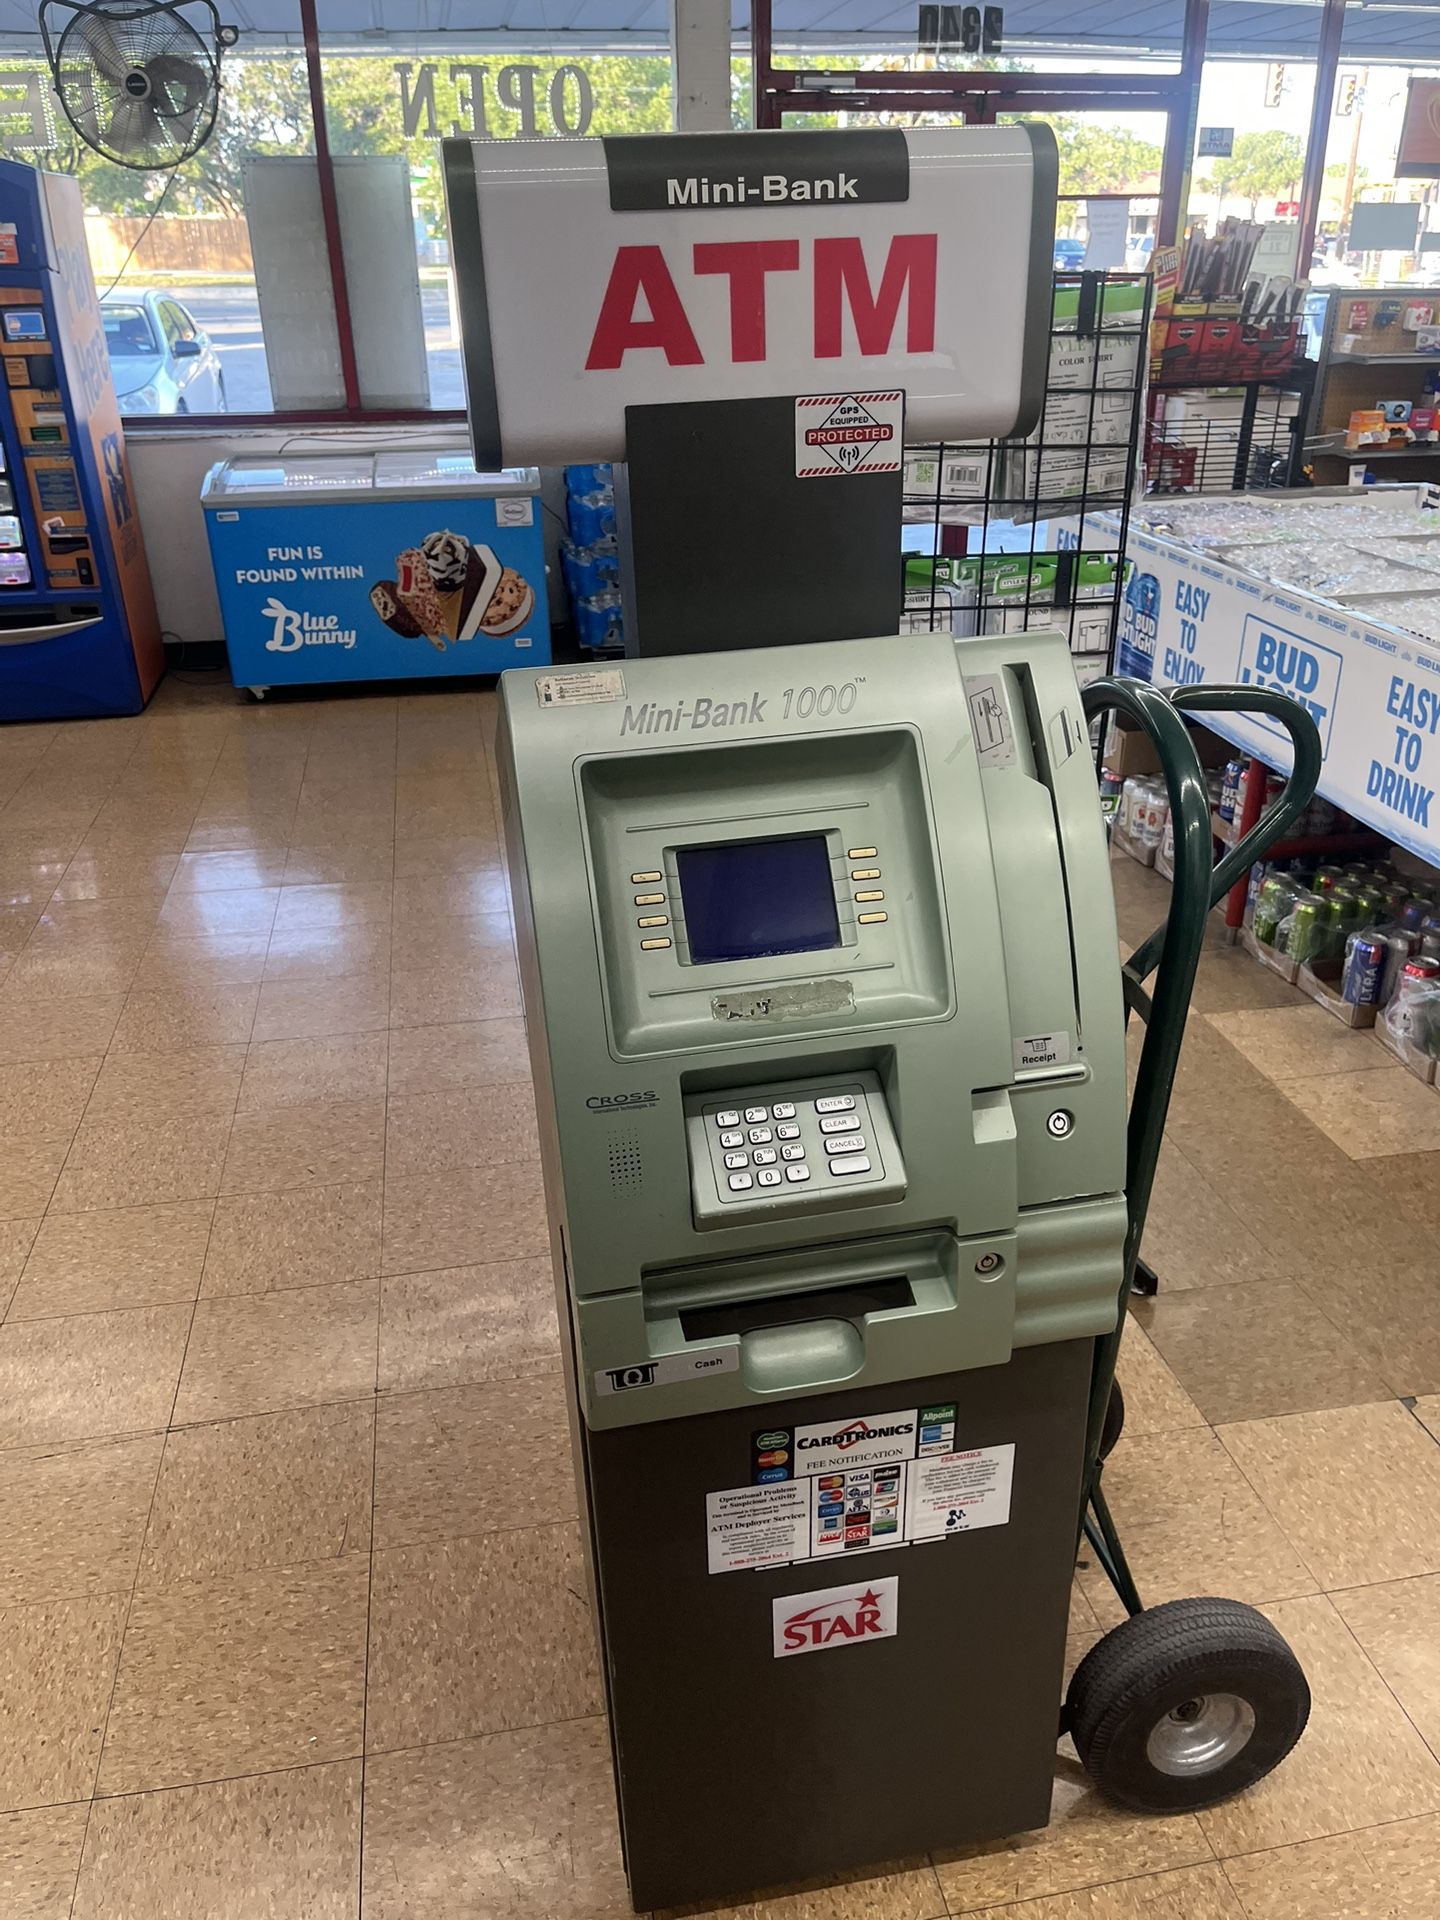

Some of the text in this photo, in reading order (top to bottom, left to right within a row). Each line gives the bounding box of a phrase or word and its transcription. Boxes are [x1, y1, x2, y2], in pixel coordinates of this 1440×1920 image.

[667, 173, 859, 205] Mini-Bank
[585, 233, 938, 371] ATM
[1059, 357, 1085, 367] COLOR
[840, 406, 859, 415] GPS
[830, 416, 869, 426] EQUIPPED
[808, 428, 890, 444] PROTECTED
[268, 546, 323, 562] FUN IS
[236, 565, 364, 584] FOUND WITHIN
[1175, 579, 1210, 622] EASY
[1028, 608, 1049, 616] OUND
[1135, 614, 1157, 639] BUD
[1329, 620, 1348, 633] LIGHT
[1181, 618, 1197, 654] TO
[1377, 640, 1397, 653] LIGHT
[1163, 647, 1205, 684] ENJOY
[1256, 632, 1319, 693] BUD
[620, 682, 857, 736] Mini-Bank 1000
[1387, 676, 1440, 735] EASY
[1394, 726, 1422, 773] TO
[1366, 760, 1435, 828] DRINK
[1022, 1053, 1056, 1065] Receipt
[586, 1091, 660, 1109] CROSS
[820, 1100, 843, 1108] ENTER
[720, 1115, 726, 1124] 1
[747, 1111, 755, 1120] 2
[776, 1107, 783, 1116] 3
[825, 1119, 847, 1128] CLEAR
[724, 1135, 731, 1144] 4
[752, 1131, 760, 1140] 5
[780, 1127, 787, 1136] 6
[829, 1140, 856, 1149] CANCEL
[728, 1156, 735, 1166] 7
[756, 1153, 764, 1162] 8
[785, 1148, 792, 1158] 9
[765, 1172, 773, 1182] 0
[695, 1357, 723, 1369] Cash
[922, 1409, 954, 1421] Allpoint
[797, 1423, 914, 1450] CARDTRONICS
[807, 1447, 904, 1471] FEE NOTIFICATION
[849, 1473, 870, 1482] VISA
[719, 1486, 797, 1503] Operational Problems
[730, 1499, 767, 1509] Suspicious
[768, 1493, 796, 1503] Activity
[711, 1513, 806, 1533] ATM Deployer Services
[847, 1529, 868, 1538] STAR
[783, 1609, 884, 1650] STAR
